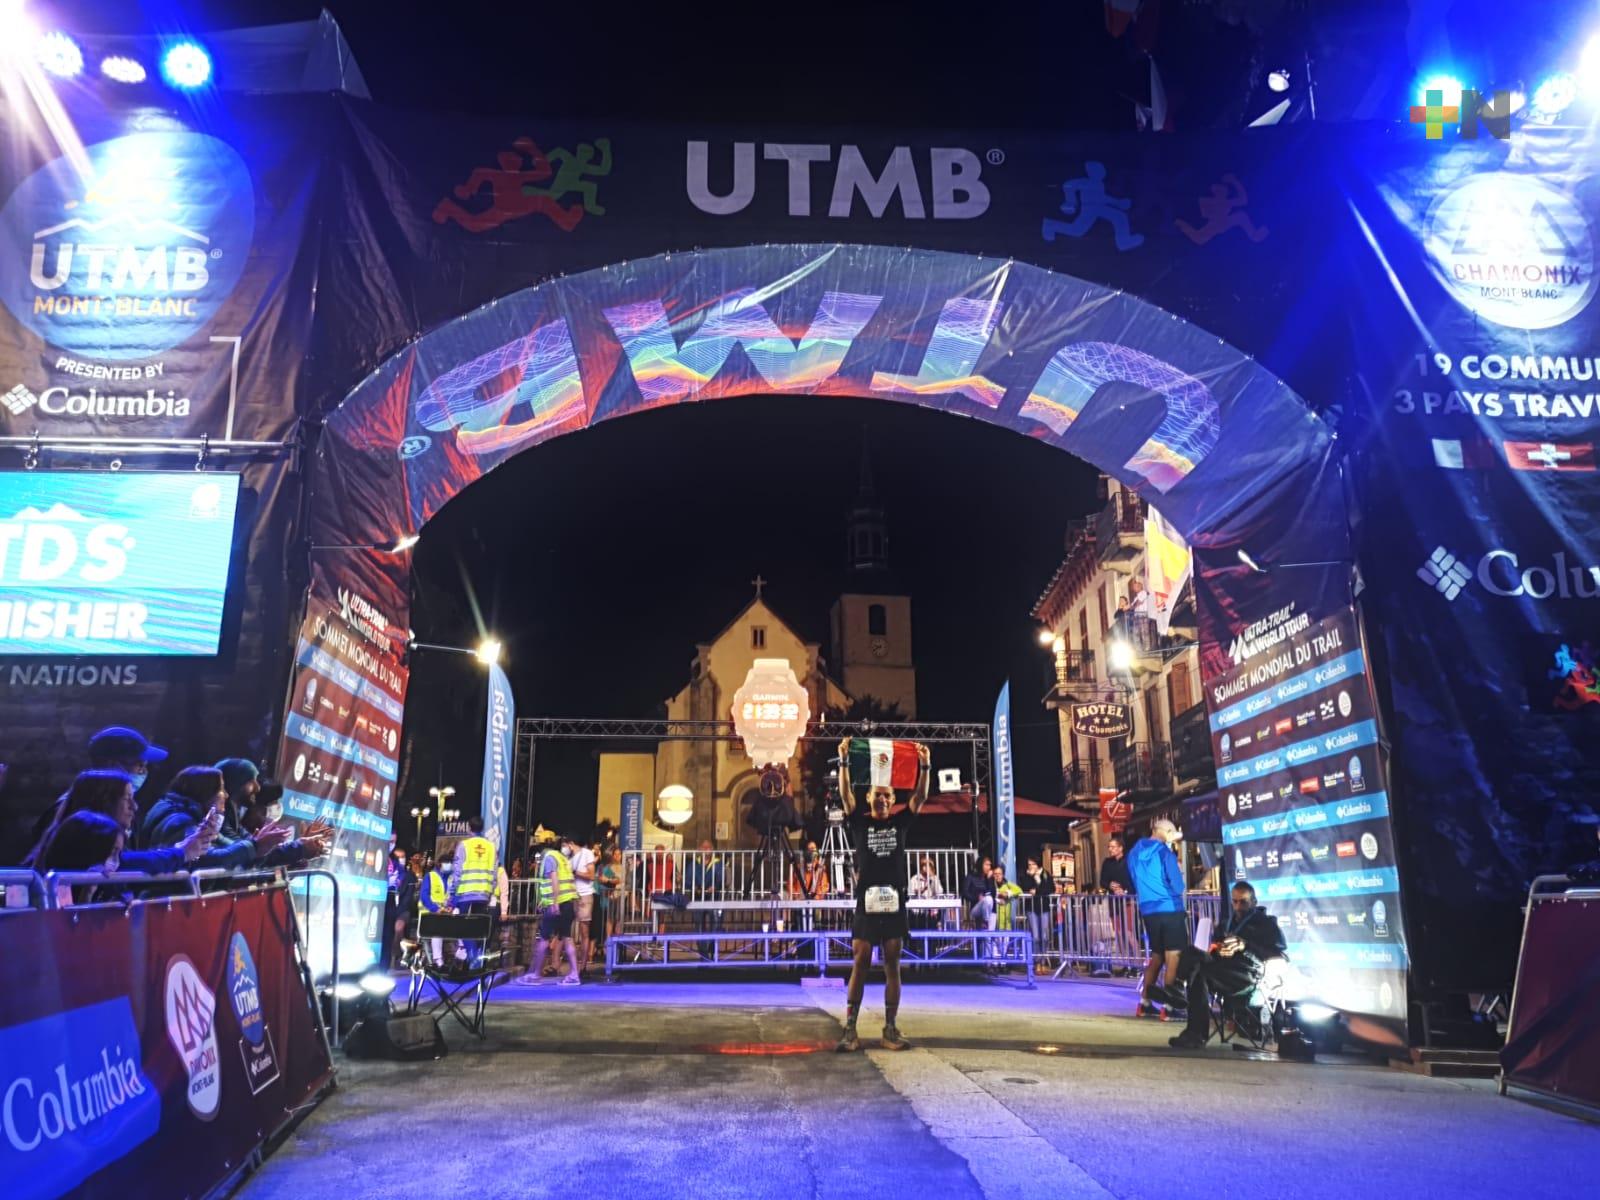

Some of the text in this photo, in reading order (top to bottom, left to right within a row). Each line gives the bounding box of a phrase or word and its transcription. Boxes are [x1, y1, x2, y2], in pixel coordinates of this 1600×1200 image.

[1453, 263, 1581, 284] CHAMONIX
[33, 294, 198, 318] MONT-BLANC
[55, 356, 165, 381] PRESENTED BY
[1415, 352, 1453, 376] 19
[39, 386, 191, 417] Columbia
[1394, 390, 1416, 414] 3
[1422, 391, 1505, 417] PAYS
[1255, 612, 1310, 652] WORLD TOUR
[313, 616, 402, 695] SOMMET MONDIAL DU TRAIL
[1214, 628, 1343, 704] SOMMET MONDIAL DU TRAIL
[10, 665, 138, 686] NATIONS
[1077, 704, 1124, 718] HOTEL
[1076, 721, 1086, 731] Le
[2, 1045, 147, 1152] Columbia
